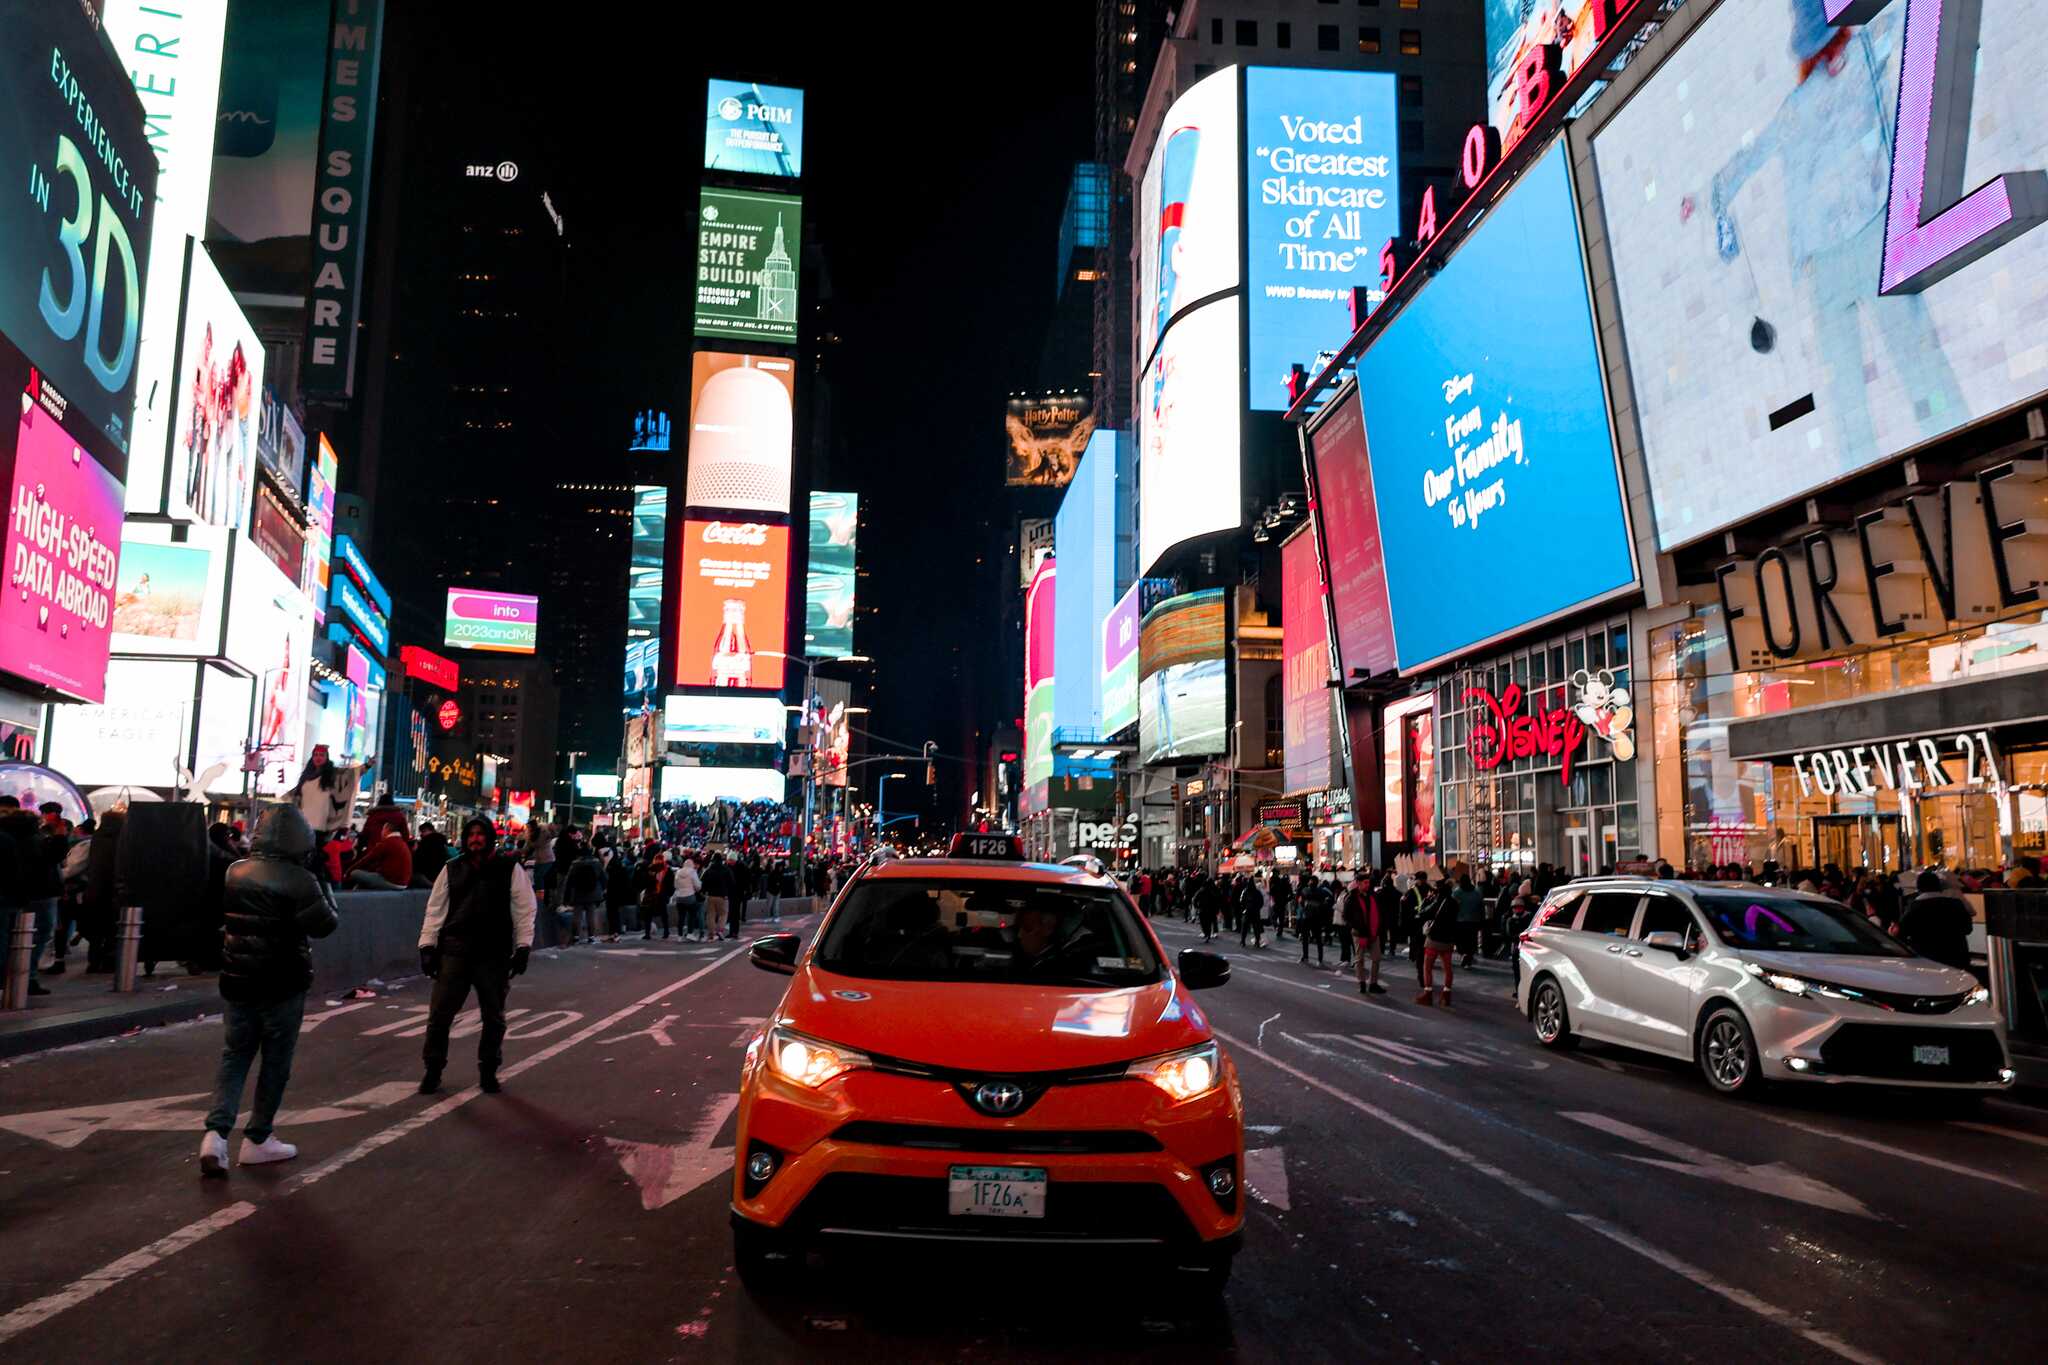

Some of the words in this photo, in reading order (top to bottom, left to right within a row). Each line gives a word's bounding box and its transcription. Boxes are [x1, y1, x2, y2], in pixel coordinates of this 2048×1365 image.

[746, 104, 793, 124] PGIM
[1280, 115, 1363, 145] Voted
[52, 48, 129, 198] EXPERIENCE
[131, 184, 144, 219] IT
[466, 164, 494, 178] anz
[30, 164, 50, 213] IN
[1262, 175, 1387, 209] Skincare
[700, 231, 757, 251] EMPIRE
[1285, 210, 1319, 239] of
[1323, 211, 1361, 240] All
[39, 135, 139, 392] 3D
[313, 150, 353, 365] SQUARE
[699, 248, 744, 267] STATE
[698, 265, 773, 288] BUILDING
[1265, 285, 1296, 298] WWD
[736, 289, 751, 299] FOR
[1424, 465, 1454, 507] Our
[1455, 410, 1524, 487] Family
[1465, 478, 1506, 530] Yours
[15, 484, 116, 590] HIGH-SPEED
[1715, 460, 2041, 671] FOREVE
[14, 542, 53, 601] DATA
[55, 569, 109, 629] ABROAD
[493, 604, 520, 618] into
[453, 623, 536, 642] 2023andMe
[1461, 683, 1585, 786] Disney
[1792, 738, 1951, 798] FOREVER
[1955, 731, 2001, 785] 21
[969, 839, 1007, 855] 1F26
